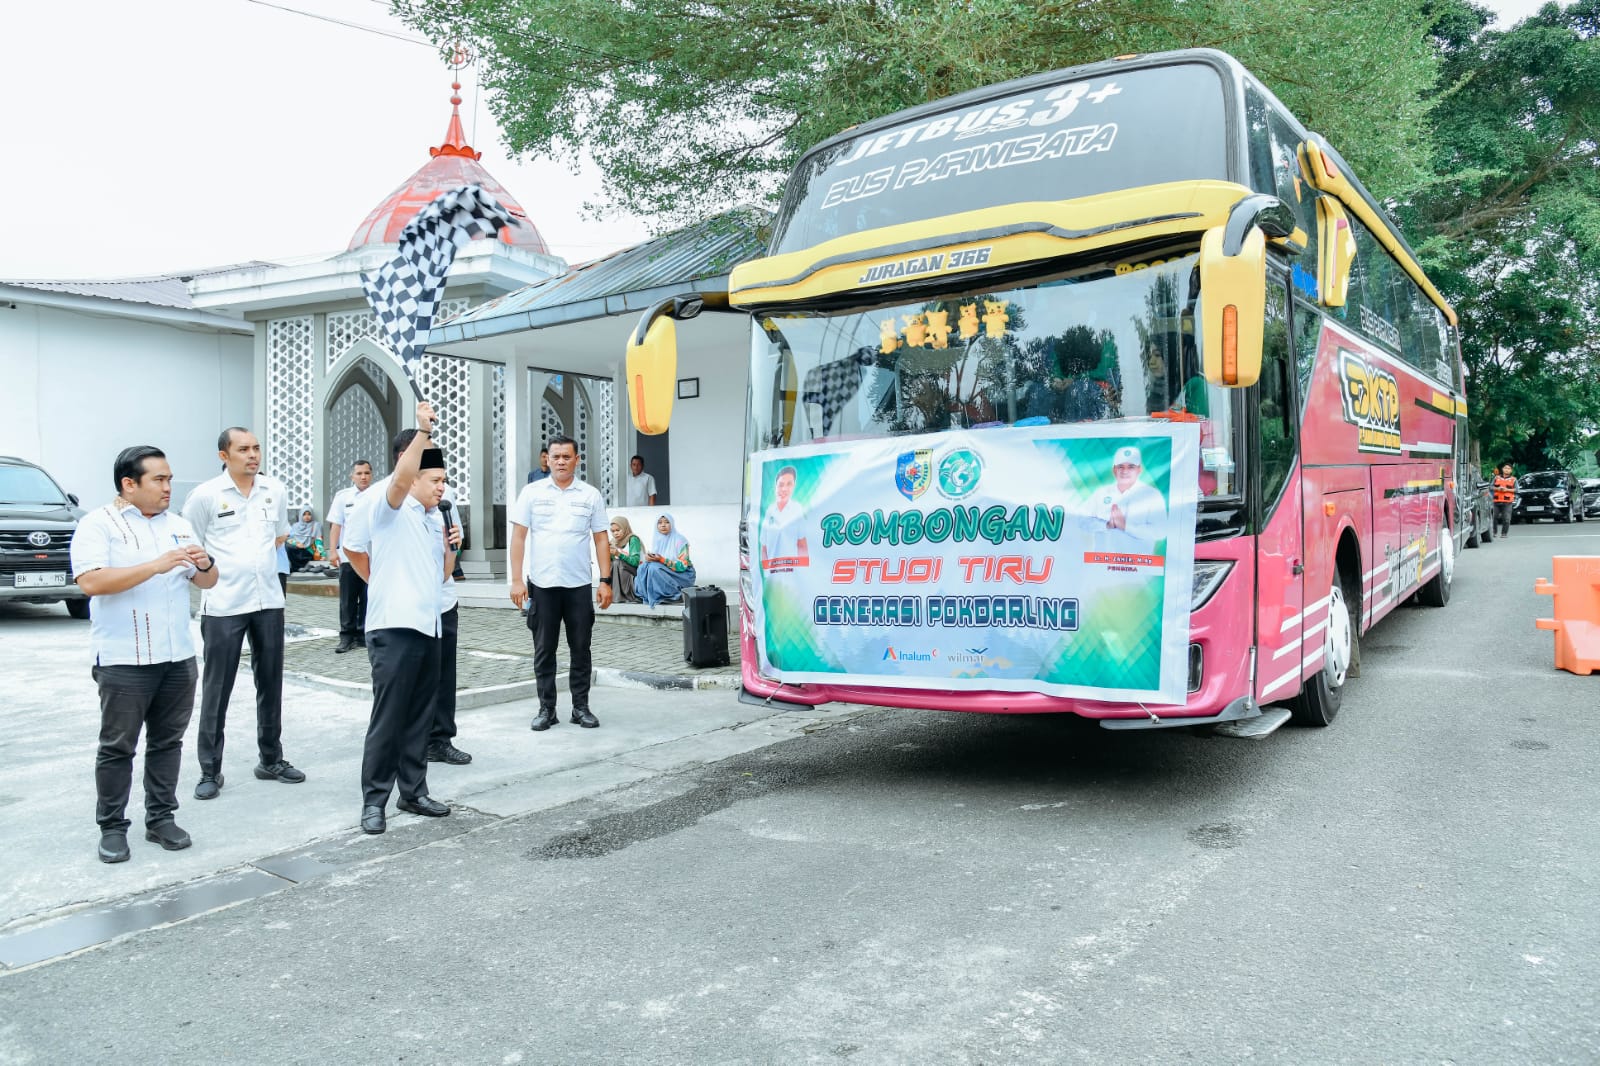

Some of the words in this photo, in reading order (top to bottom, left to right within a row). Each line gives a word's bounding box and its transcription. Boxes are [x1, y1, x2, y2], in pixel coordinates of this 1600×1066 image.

[820, 165, 896, 210] BUS
[893, 122, 1119, 190] PARIWISATA
[858, 253, 946, 285] JURAGAN
[947, 246, 992, 269] 366
[821, 503, 1064, 548] ROMBONGAN
[17, 575, 27, 583] BK
[831, 556, 943, 584] STUDI
[958, 555, 1054, 584] TIRU
[814, 595, 922, 627] GENERASI
[927, 595, 1079, 631] POKDARLING
[899, 651, 931, 662] Inalum
[947, 652, 985, 664] wilmar
